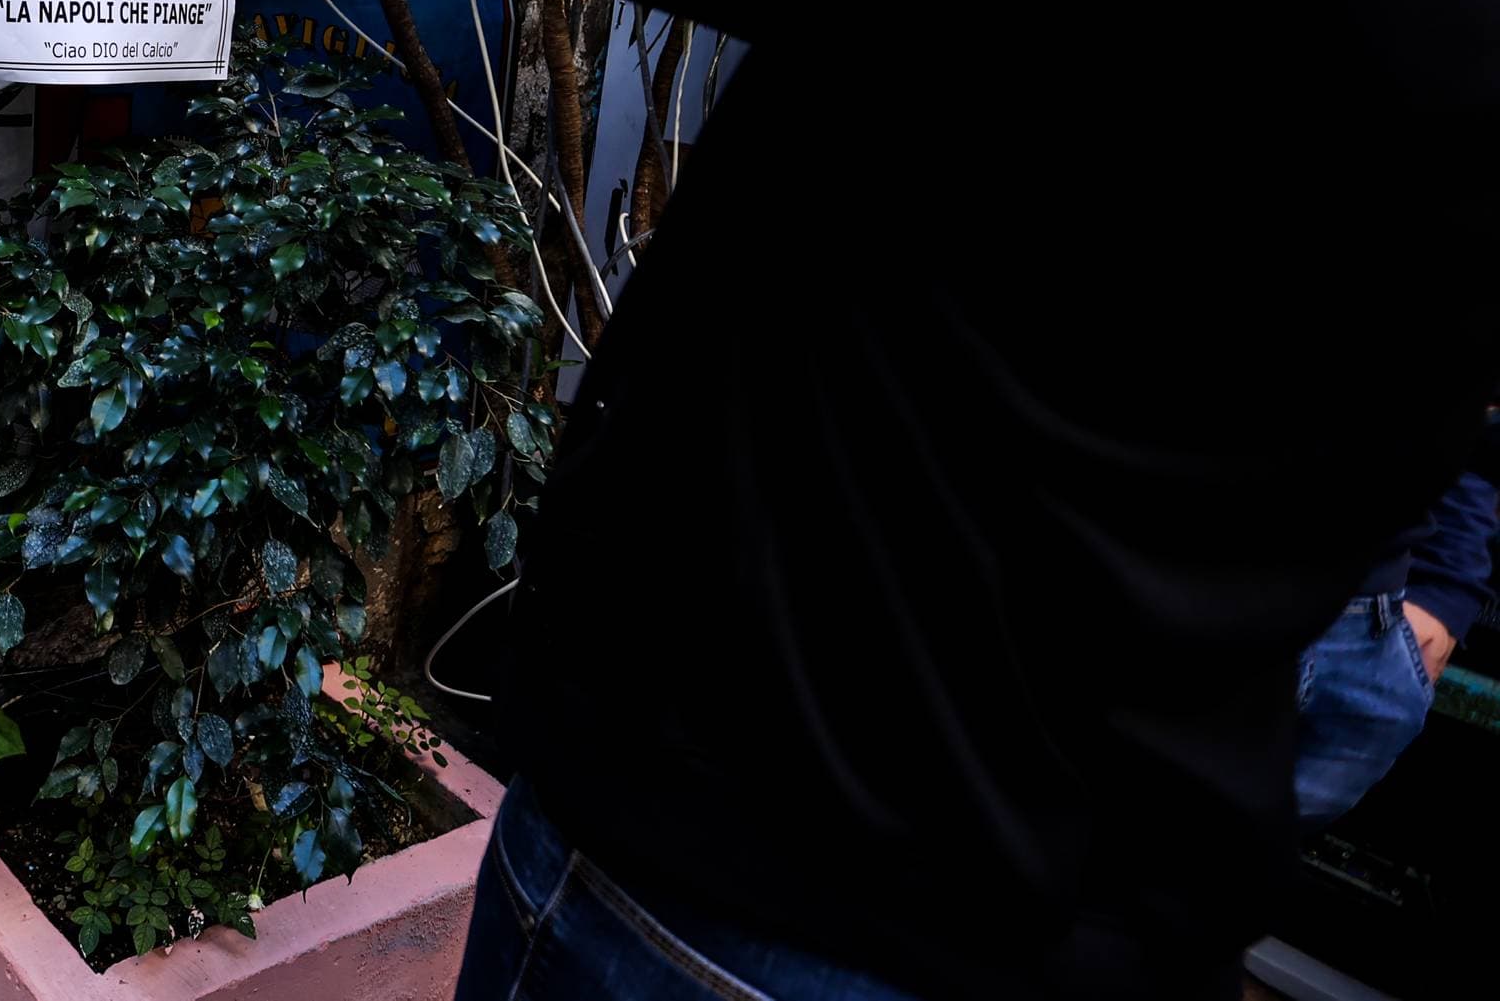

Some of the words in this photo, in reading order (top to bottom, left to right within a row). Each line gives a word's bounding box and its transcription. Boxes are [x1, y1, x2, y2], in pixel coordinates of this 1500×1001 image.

[39, 1, 114, 24] NAPOLI
[120, 3, 148, 24] CHE
[93, 42, 118, 58] DIO
[122, 41, 139, 58] del
